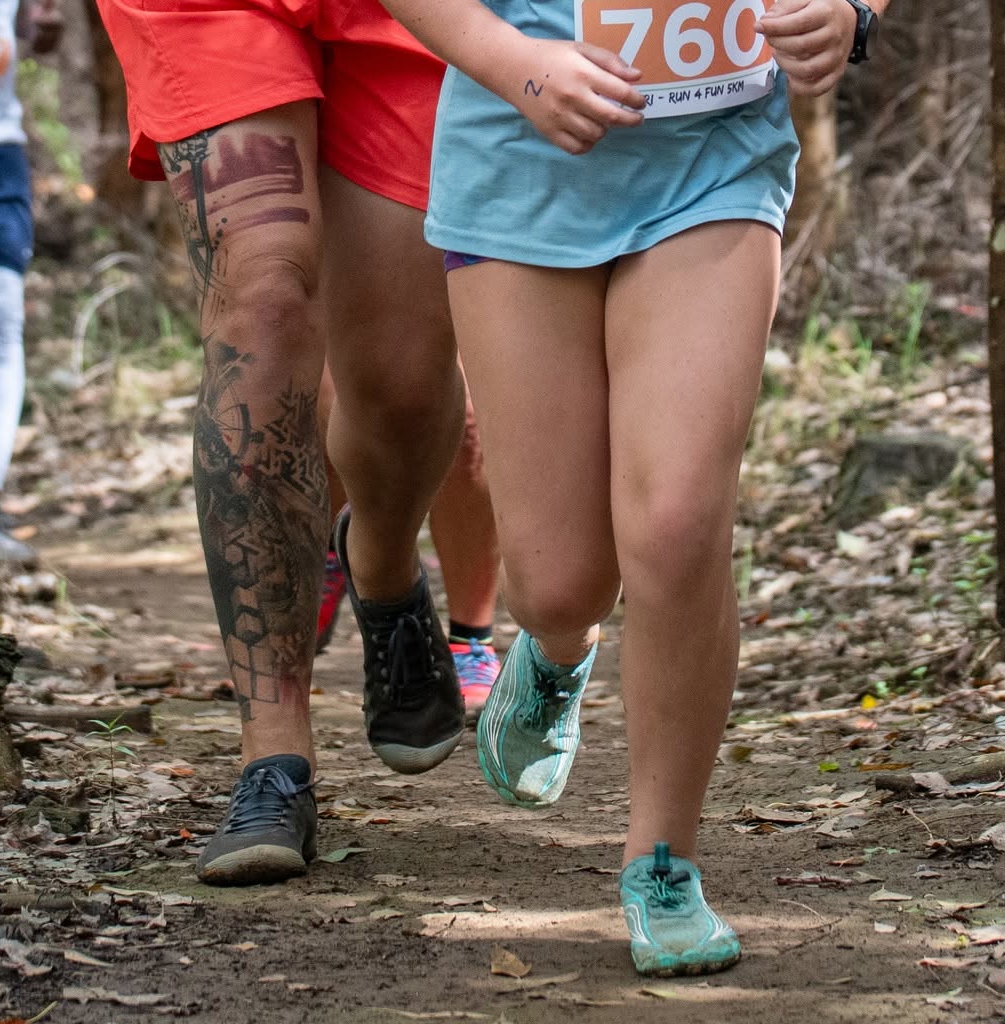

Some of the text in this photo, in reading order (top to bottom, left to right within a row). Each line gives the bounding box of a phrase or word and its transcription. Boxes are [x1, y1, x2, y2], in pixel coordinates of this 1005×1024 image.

[668, 90, 691, 103] RUN
[694, 88, 702, 99] 4
[705, 85, 725, 99] FUN
[727, 80, 745, 94] 5KM
